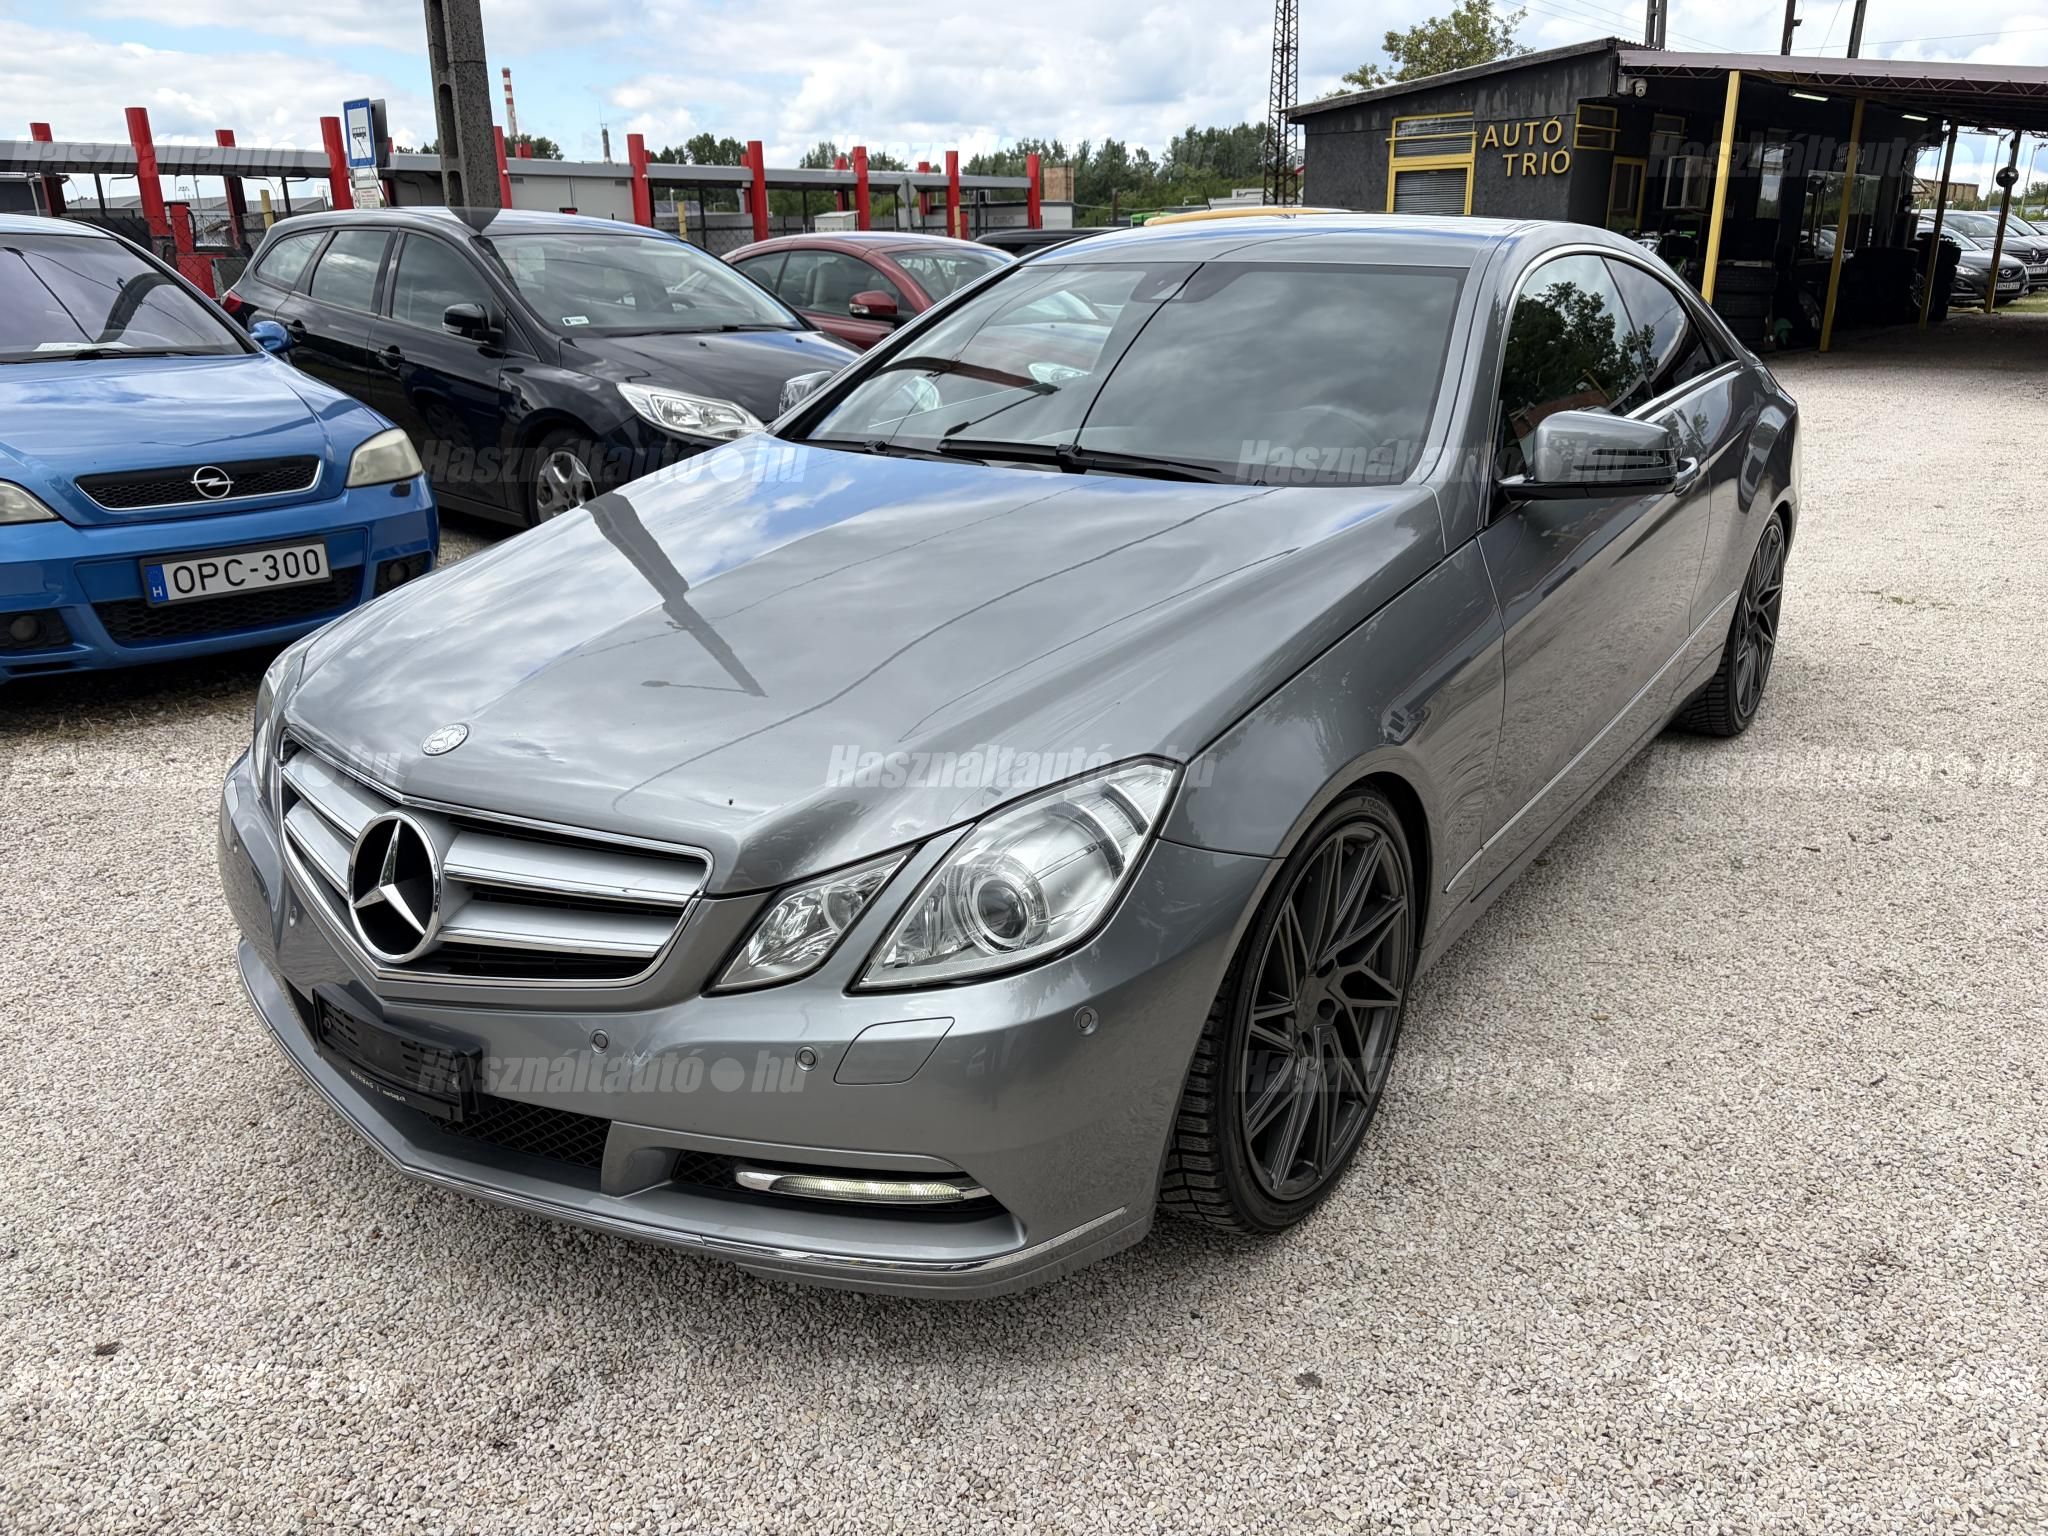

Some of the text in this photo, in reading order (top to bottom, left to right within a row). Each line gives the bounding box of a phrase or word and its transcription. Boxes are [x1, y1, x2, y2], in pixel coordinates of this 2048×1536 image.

[1481, 115, 1562, 149] AUTÓ
[1502, 145, 1570, 177] TRIÓ
[172, 549, 321, 594] OPC-300
